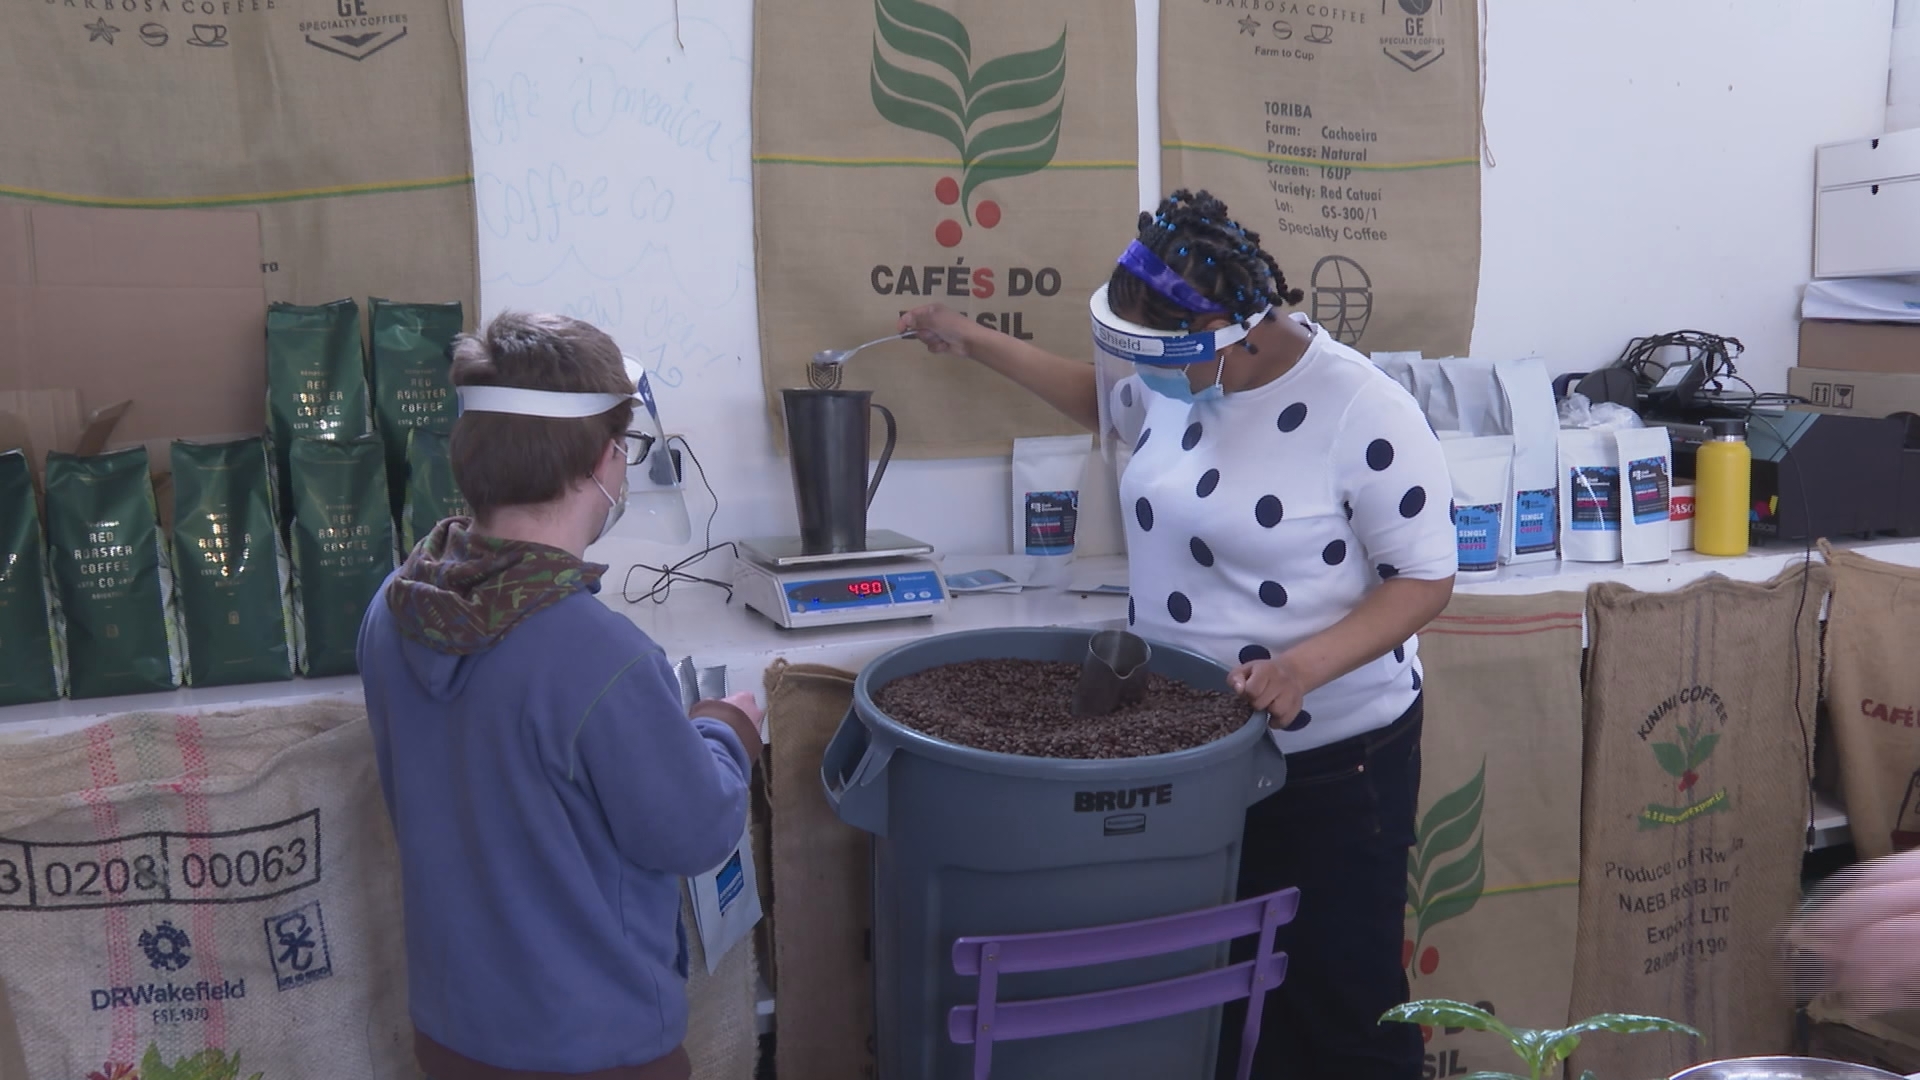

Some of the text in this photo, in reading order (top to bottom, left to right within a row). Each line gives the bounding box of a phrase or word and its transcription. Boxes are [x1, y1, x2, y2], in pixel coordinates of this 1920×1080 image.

[299, 14, 408, 32] SPECIALTY COFFEES
[1306, 4, 1366, 24] COFFEE
[1405, 17, 1425, 36] GE
[1255, 46, 1315, 61] Farm to Cup
[1264, 101, 1313, 119] TORIBA
[1265, 120, 1377, 142] Farm: Cachoeira
[1267, 139, 1368, 162] Process: Natural
[1267, 160, 1352, 181] Screen: 16UP
[1269, 179, 1316, 201] Variety:
[1320, 185, 1342, 201] Red
[1274, 198, 1377, 224] Lot: GS-300/1
[1279, 217, 1388, 243] Specialty Coffee
[871, 256, 1062, 299] CAFÉS DO
[899, 310, 1034, 341] SIL
[1098, 322, 1141, 352] Shield
[73, 545, 133, 560] ROASTER
[848, 581, 882, 595] 490
[1637, 684, 1729, 741] KININI COFFEE
[1074, 783, 1173, 812] BRUTE
[45, 854, 157, 897] 0208
[182, 838, 307, 889] 00063
[1605, 861, 1671, 882] Produce
[1677, 849, 1694, 870] of
[91, 977, 246, 1012] DRWakefield
